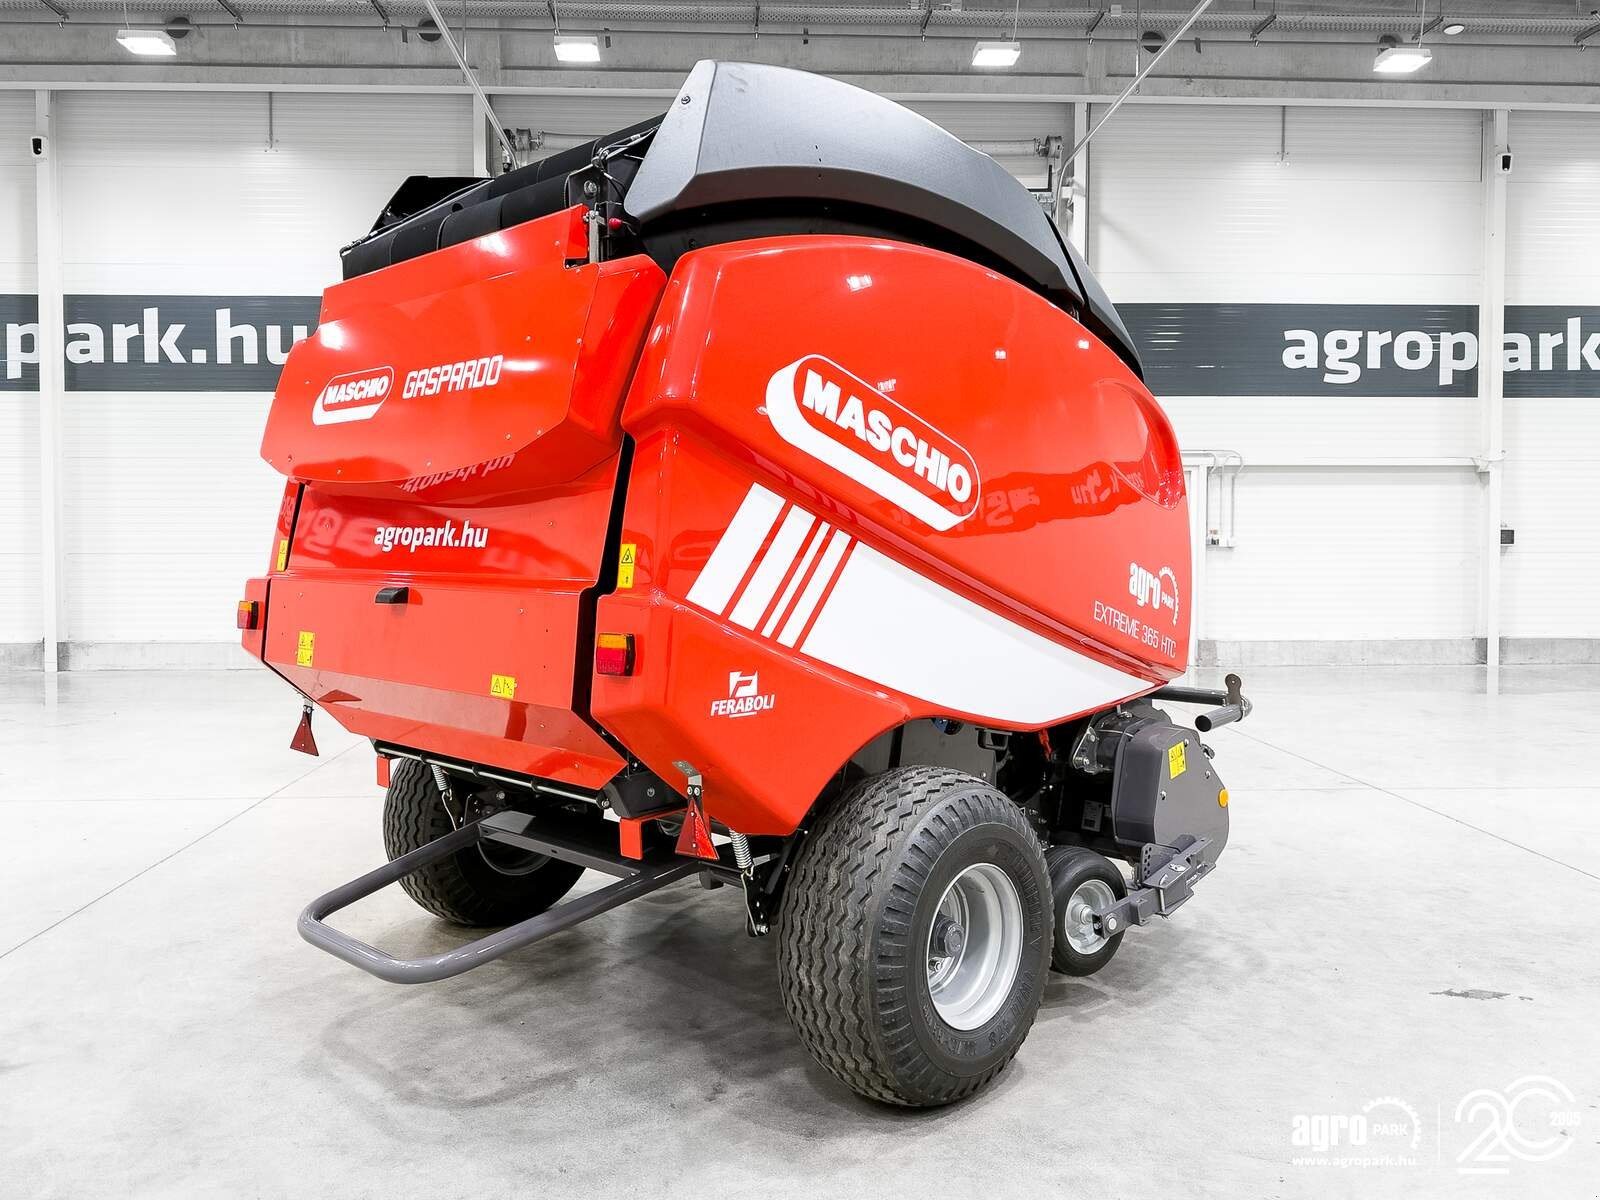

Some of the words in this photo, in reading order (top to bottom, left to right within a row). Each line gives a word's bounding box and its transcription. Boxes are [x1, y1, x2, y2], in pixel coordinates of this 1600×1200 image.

[324, 375, 389, 405] MASCHIO
[402, 354, 504, 400] GASPARDO
[802, 369, 972, 503] MASCHIO
[374, 520, 489, 553] agropark.hu
[1129, 562, 1161, 610] agro
[1161, 591, 1175, 610] PARK
[1094, 600, 1140, 640] EXTREME
[1142, 625, 1159, 649] 365
[1161, 635, 1177, 658] HTC
[710, 694, 775, 717] FERABOLI
